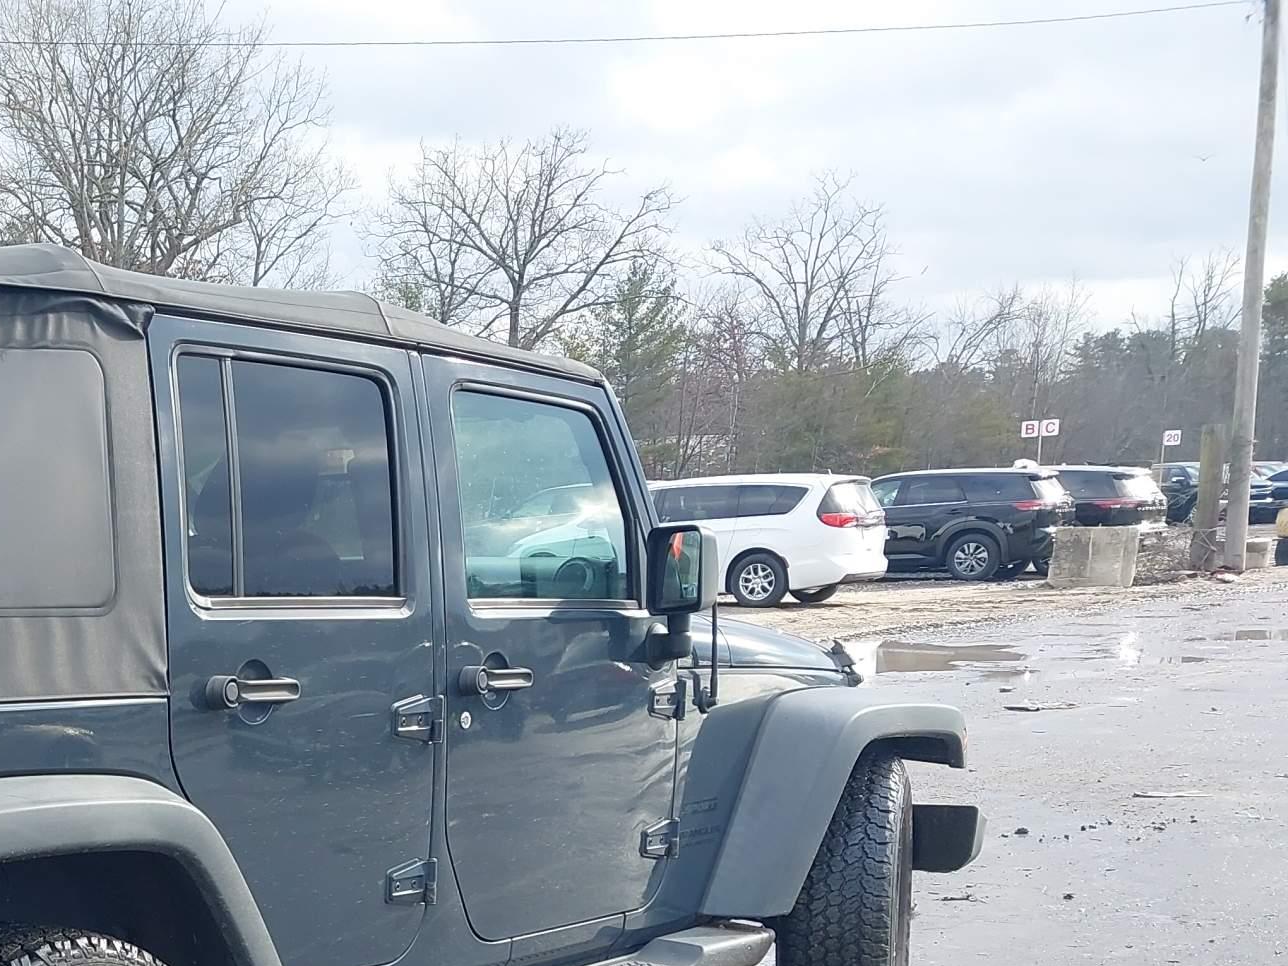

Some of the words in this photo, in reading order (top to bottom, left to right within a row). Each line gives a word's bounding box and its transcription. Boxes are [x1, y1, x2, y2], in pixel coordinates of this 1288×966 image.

[1025, 424, 1035, 435] B
[1045, 422, 1056, 434] C
[1166, 433, 1179, 443] 20
